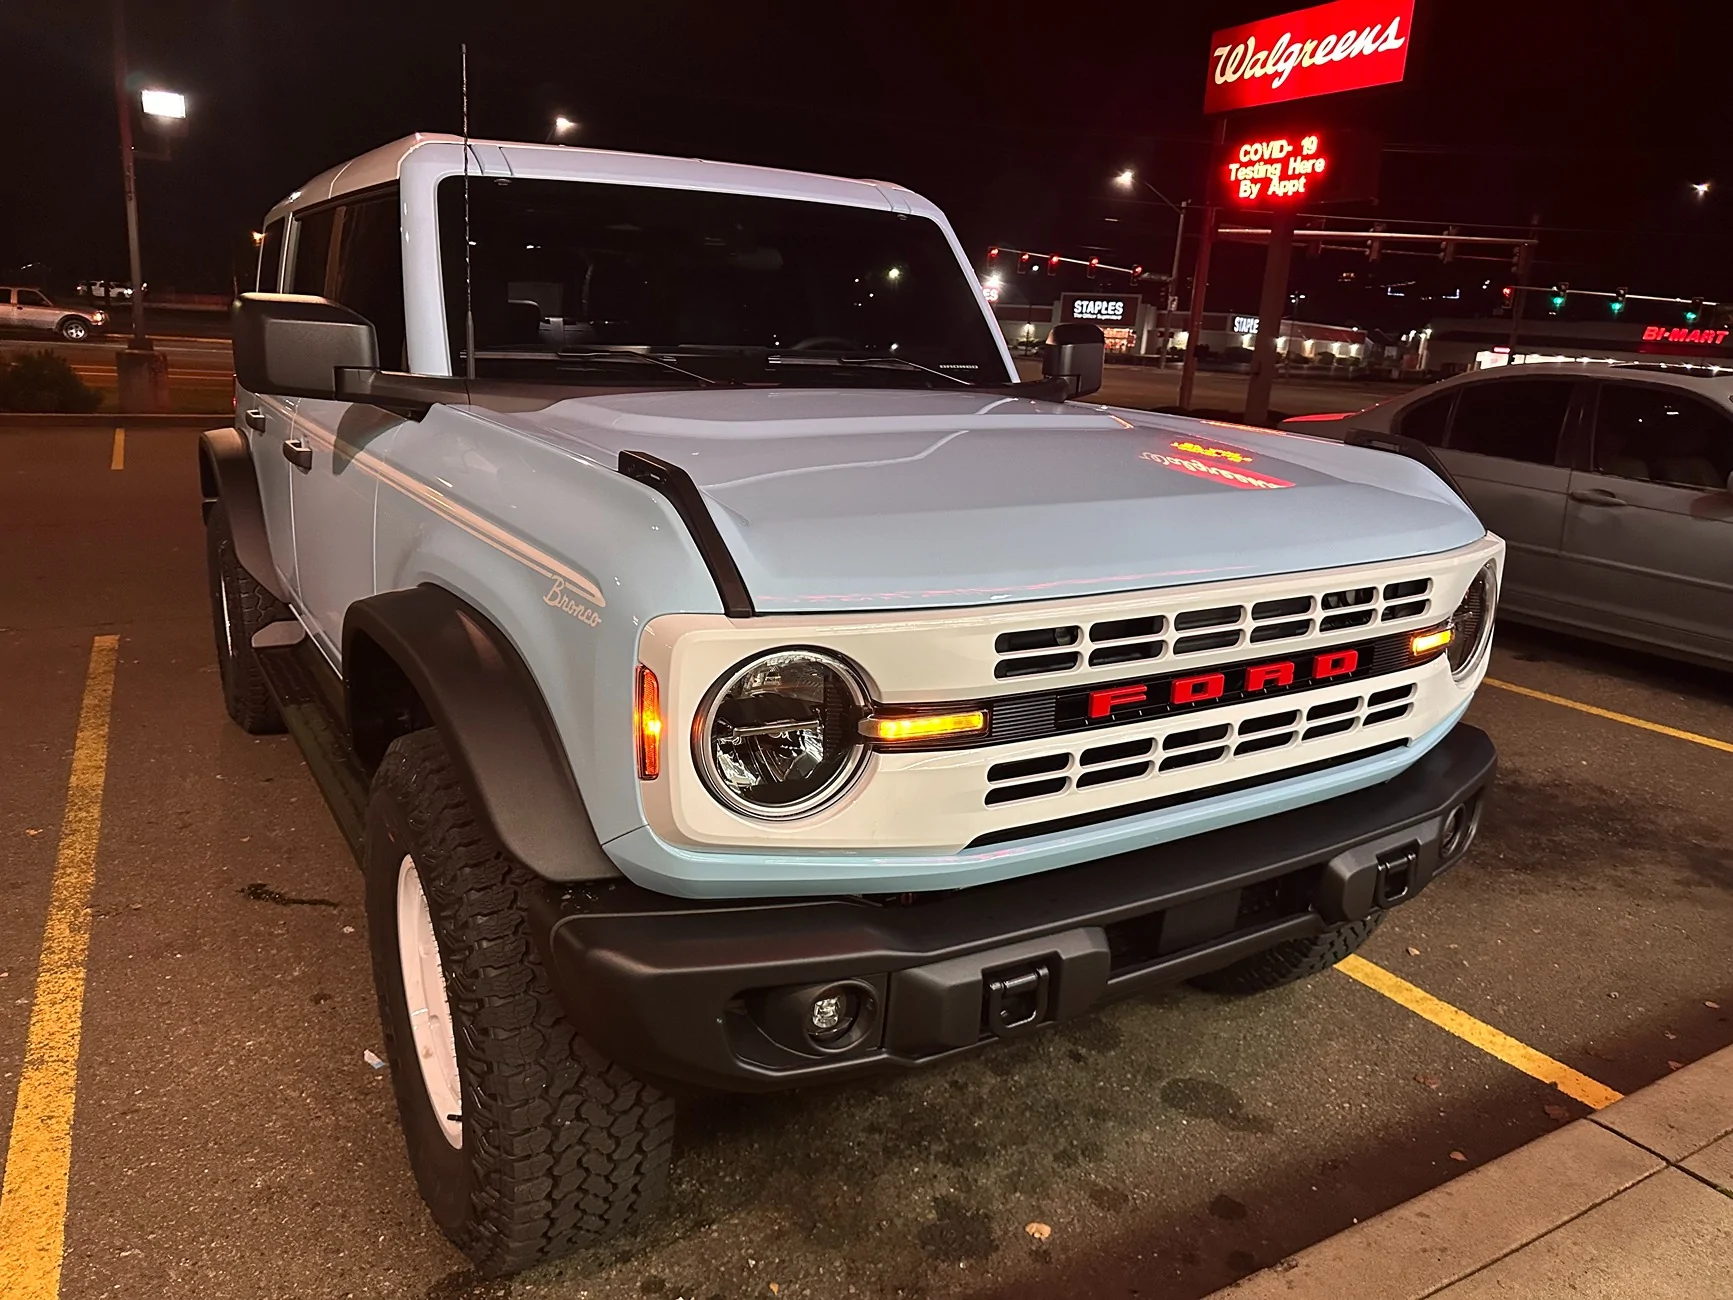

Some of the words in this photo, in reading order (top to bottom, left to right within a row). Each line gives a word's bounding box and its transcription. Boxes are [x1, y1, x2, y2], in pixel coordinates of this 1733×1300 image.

[1213, 16, 1405, 89] Walgreens
[1239, 139, 1293, 162] COVID-
[1301, 136, 1318, 155] 19
[1228, 161, 1282, 181] Testing
[1287, 156, 1325, 175] Here
[1238, 179, 1261, 199] By
[1267, 175, 1306, 196] Appt
[1073, 300, 1124, 314] STAPLES
[1233, 316, 1260, 334] STAPLE
[1642, 326, 1729, 344] BI-MART
[542, 574, 602, 627] Bronco
[1088, 650, 1358, 718] FORD
